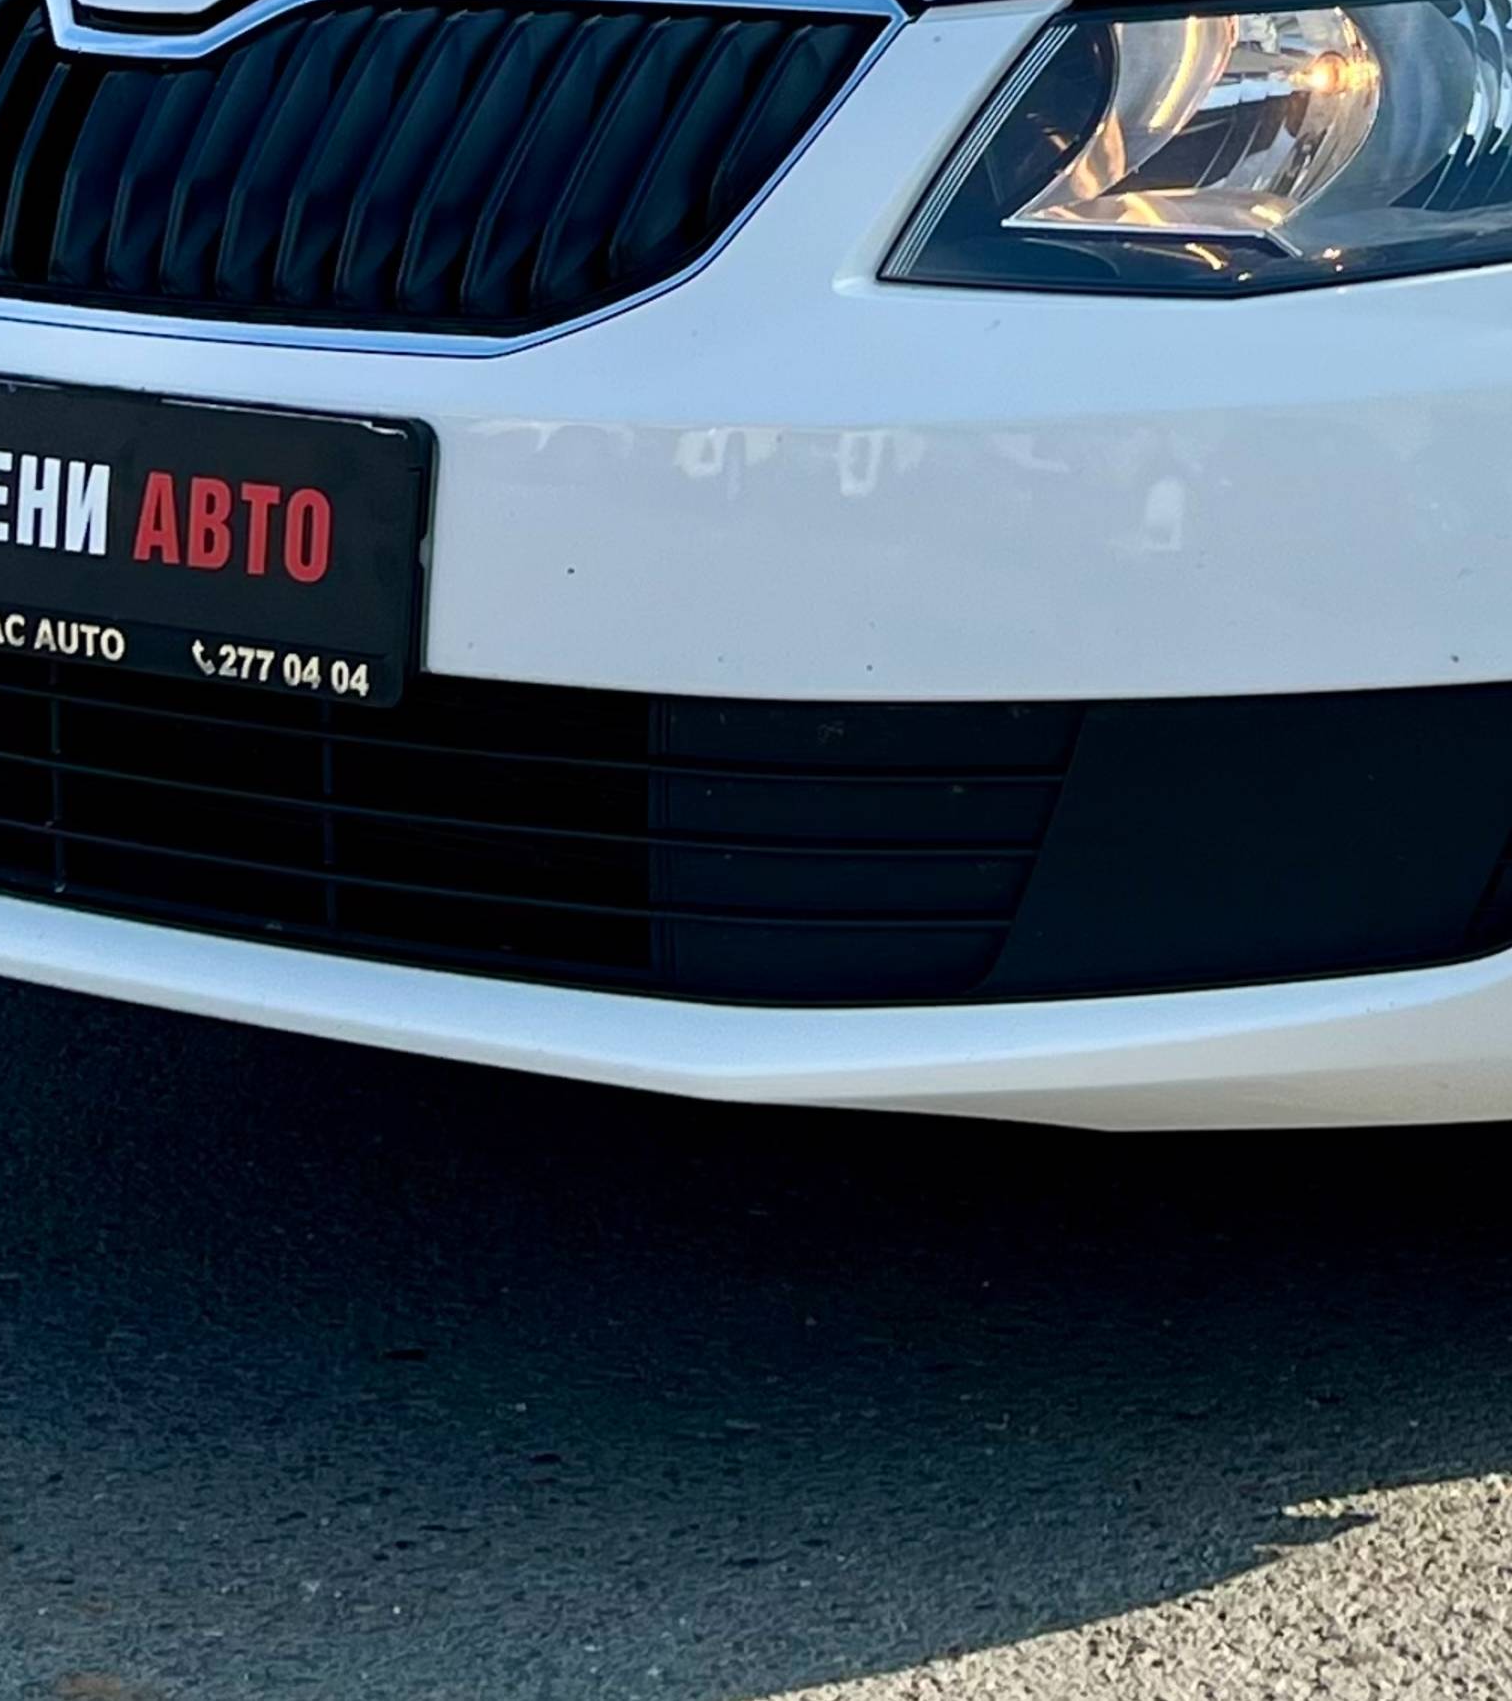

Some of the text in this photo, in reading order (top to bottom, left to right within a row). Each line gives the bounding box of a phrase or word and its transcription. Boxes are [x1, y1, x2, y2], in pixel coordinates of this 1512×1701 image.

[133, 470, 333, 584] АВТО
[34, 618, 126, 663] AUTO
[217, 642, 371, 699] 277 04 04
